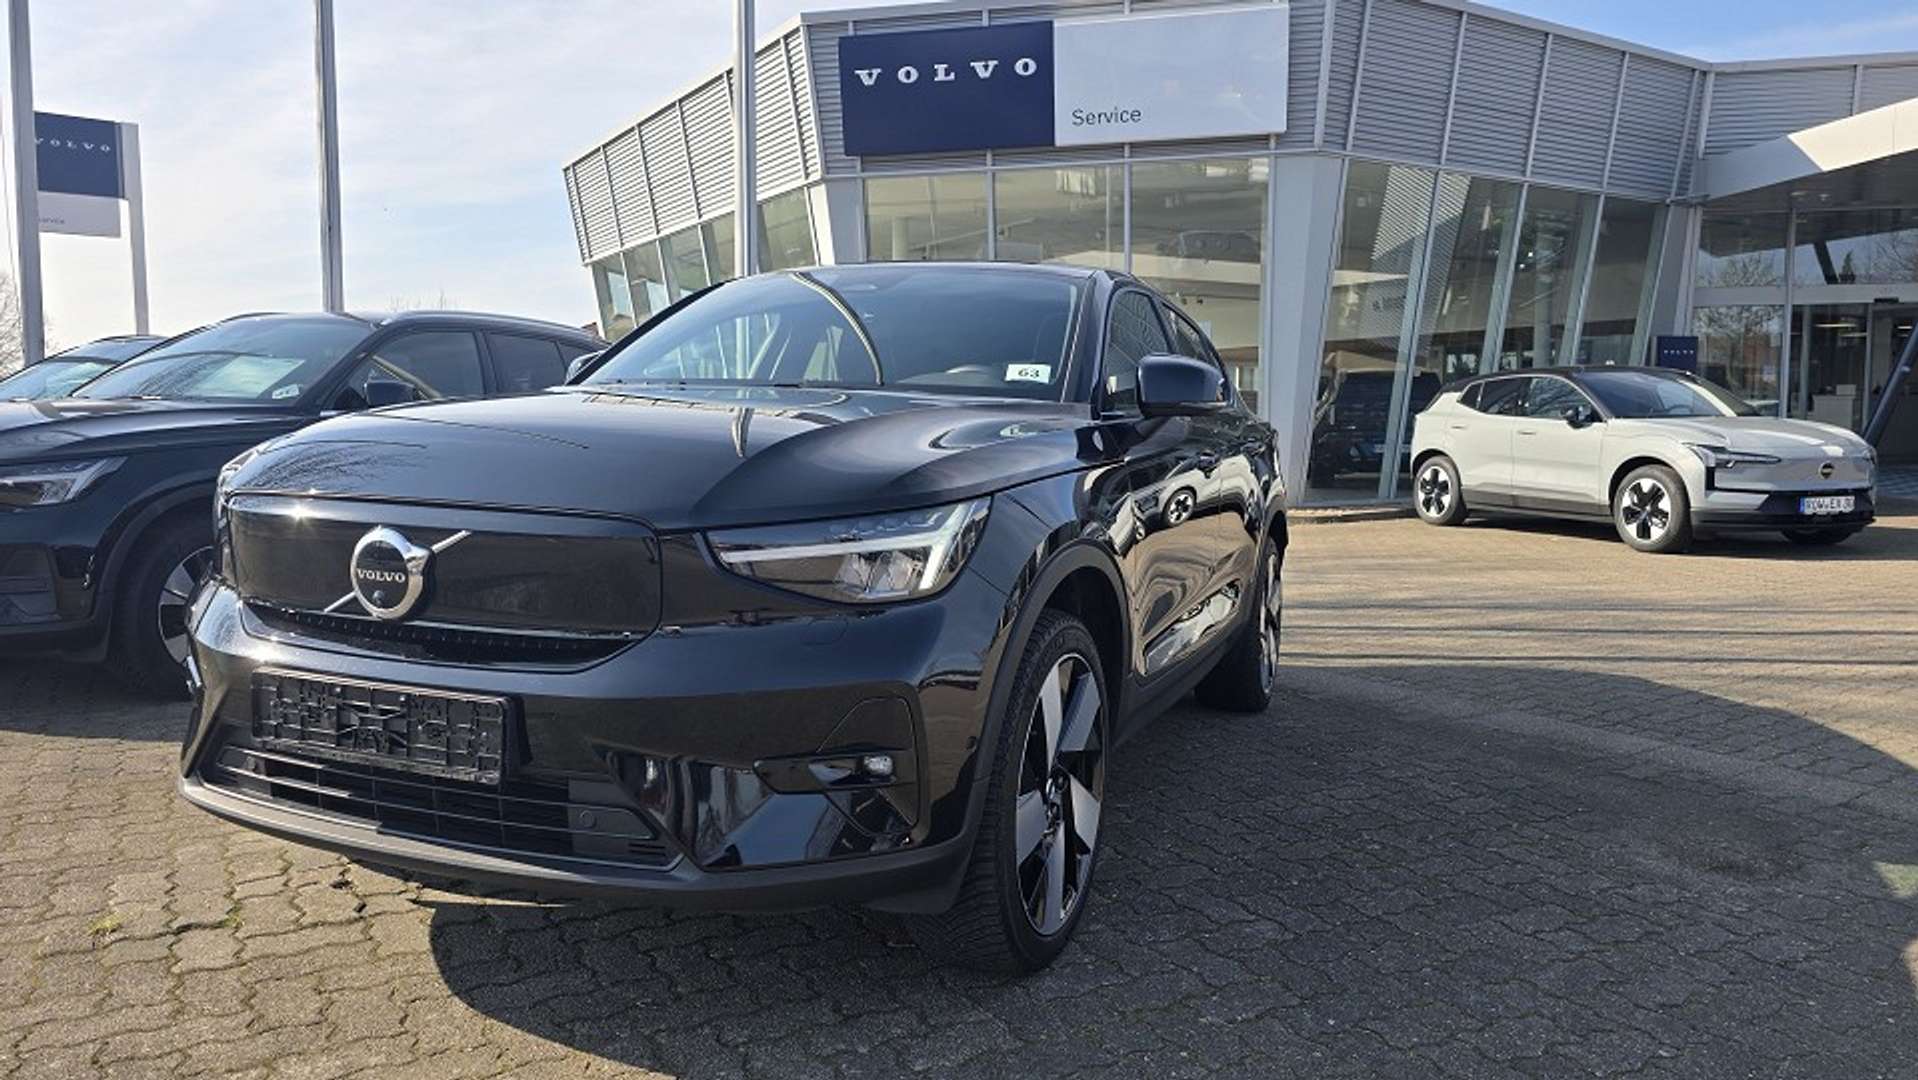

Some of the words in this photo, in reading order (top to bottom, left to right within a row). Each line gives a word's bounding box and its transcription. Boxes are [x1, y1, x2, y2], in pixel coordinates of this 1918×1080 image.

[855, 57, 1037, 86] VOLVO
[1071, 107, 1142, 126] Service
[1018, 368, 1039, 379] 63
[357, 569, 406, 583] VOLVO
